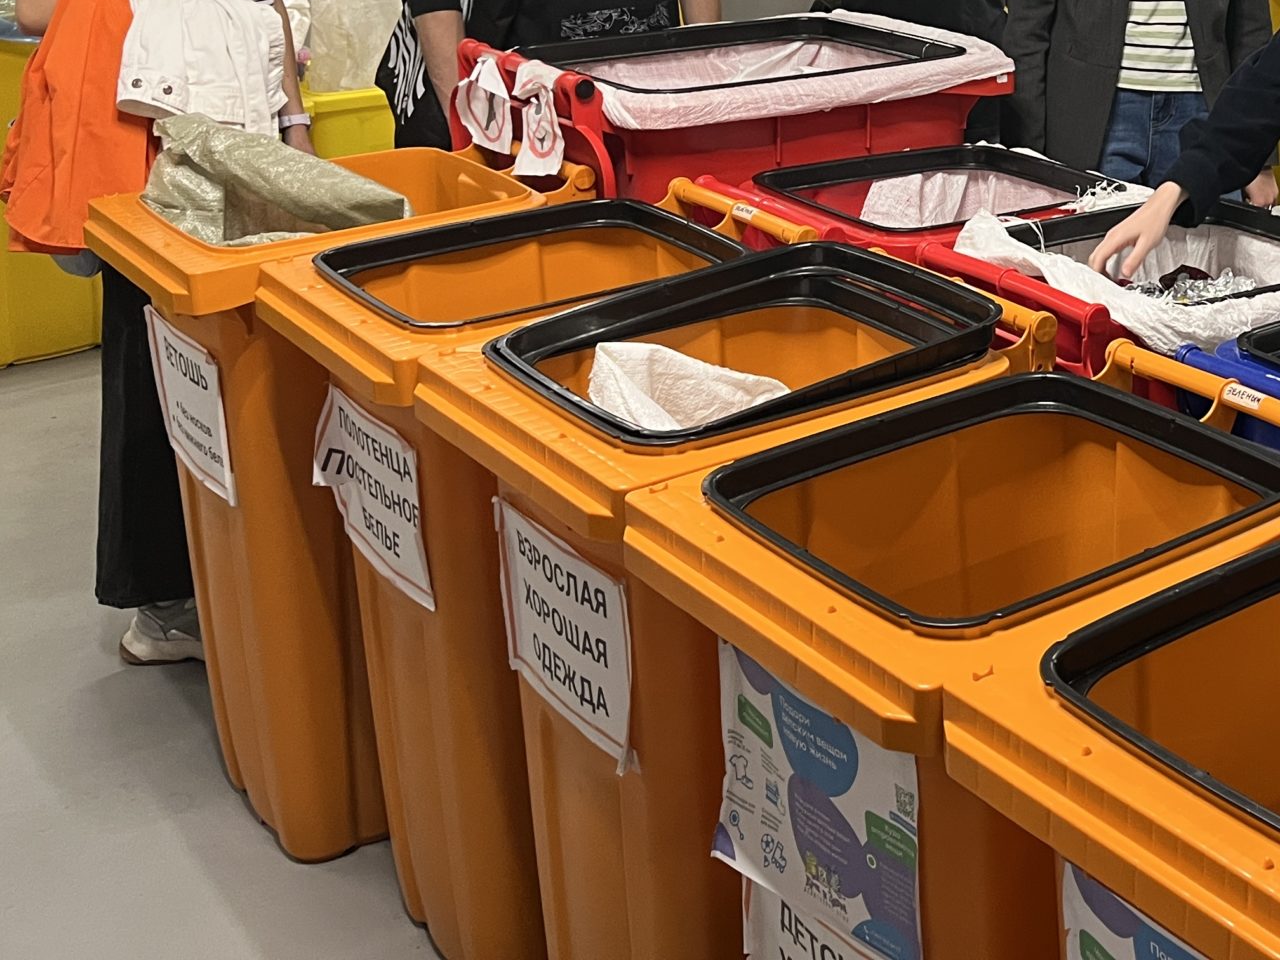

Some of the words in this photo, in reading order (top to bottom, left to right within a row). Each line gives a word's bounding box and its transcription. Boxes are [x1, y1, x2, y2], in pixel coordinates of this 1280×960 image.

[163, 335, 209, 391] ВЕТОШЬ
[338, 405, 413, 484] ПОЛОТЕНЦА
[362, 506, 401, 559] БЕЛЬЕ
[515, 528, 608, 619] ВЗРОСЛАЯ
[523, 577, 609, 670] ХОРОШАЯ
[532, 632, 610, 718] ОДЕЖДА
